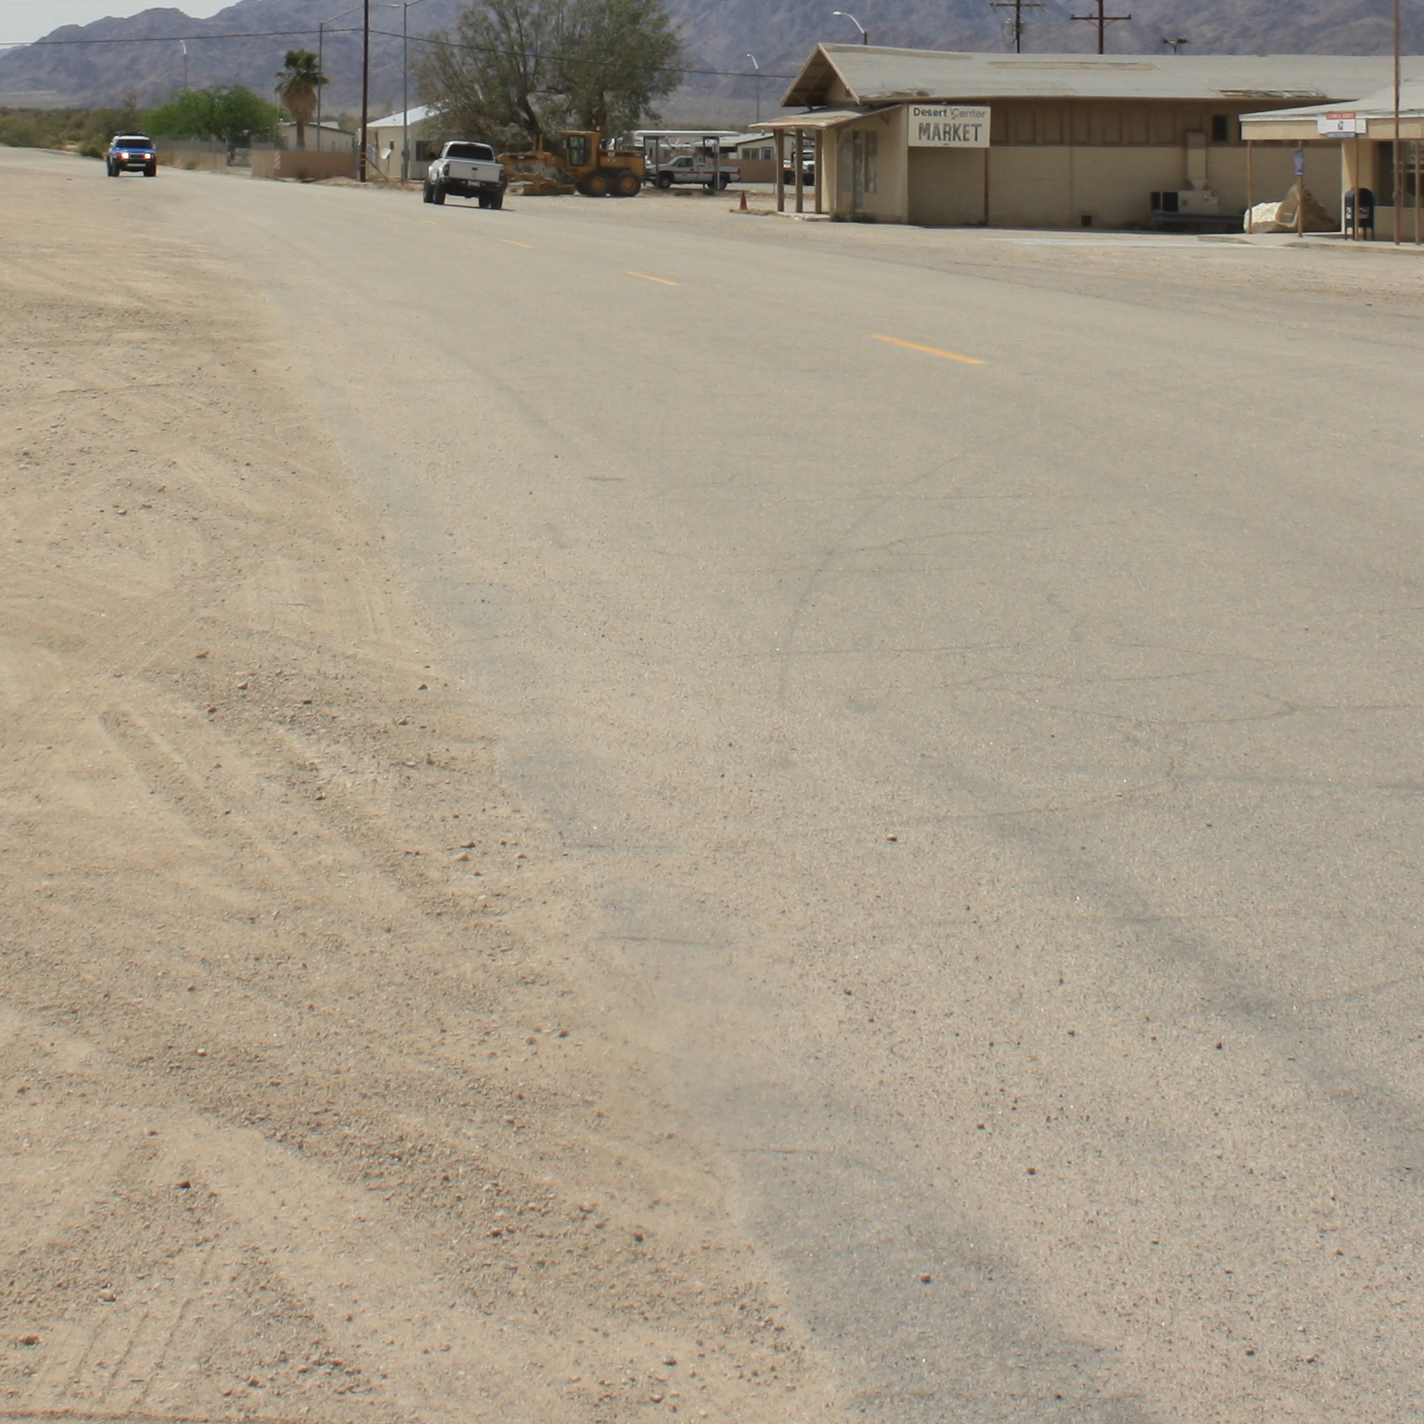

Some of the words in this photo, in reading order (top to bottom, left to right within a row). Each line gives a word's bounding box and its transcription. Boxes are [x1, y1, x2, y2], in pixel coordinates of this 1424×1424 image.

[913, 107, 947, 117] Desert
[950, 108, 986, 118] Center
[918, 122, 982, 142] MARKET
